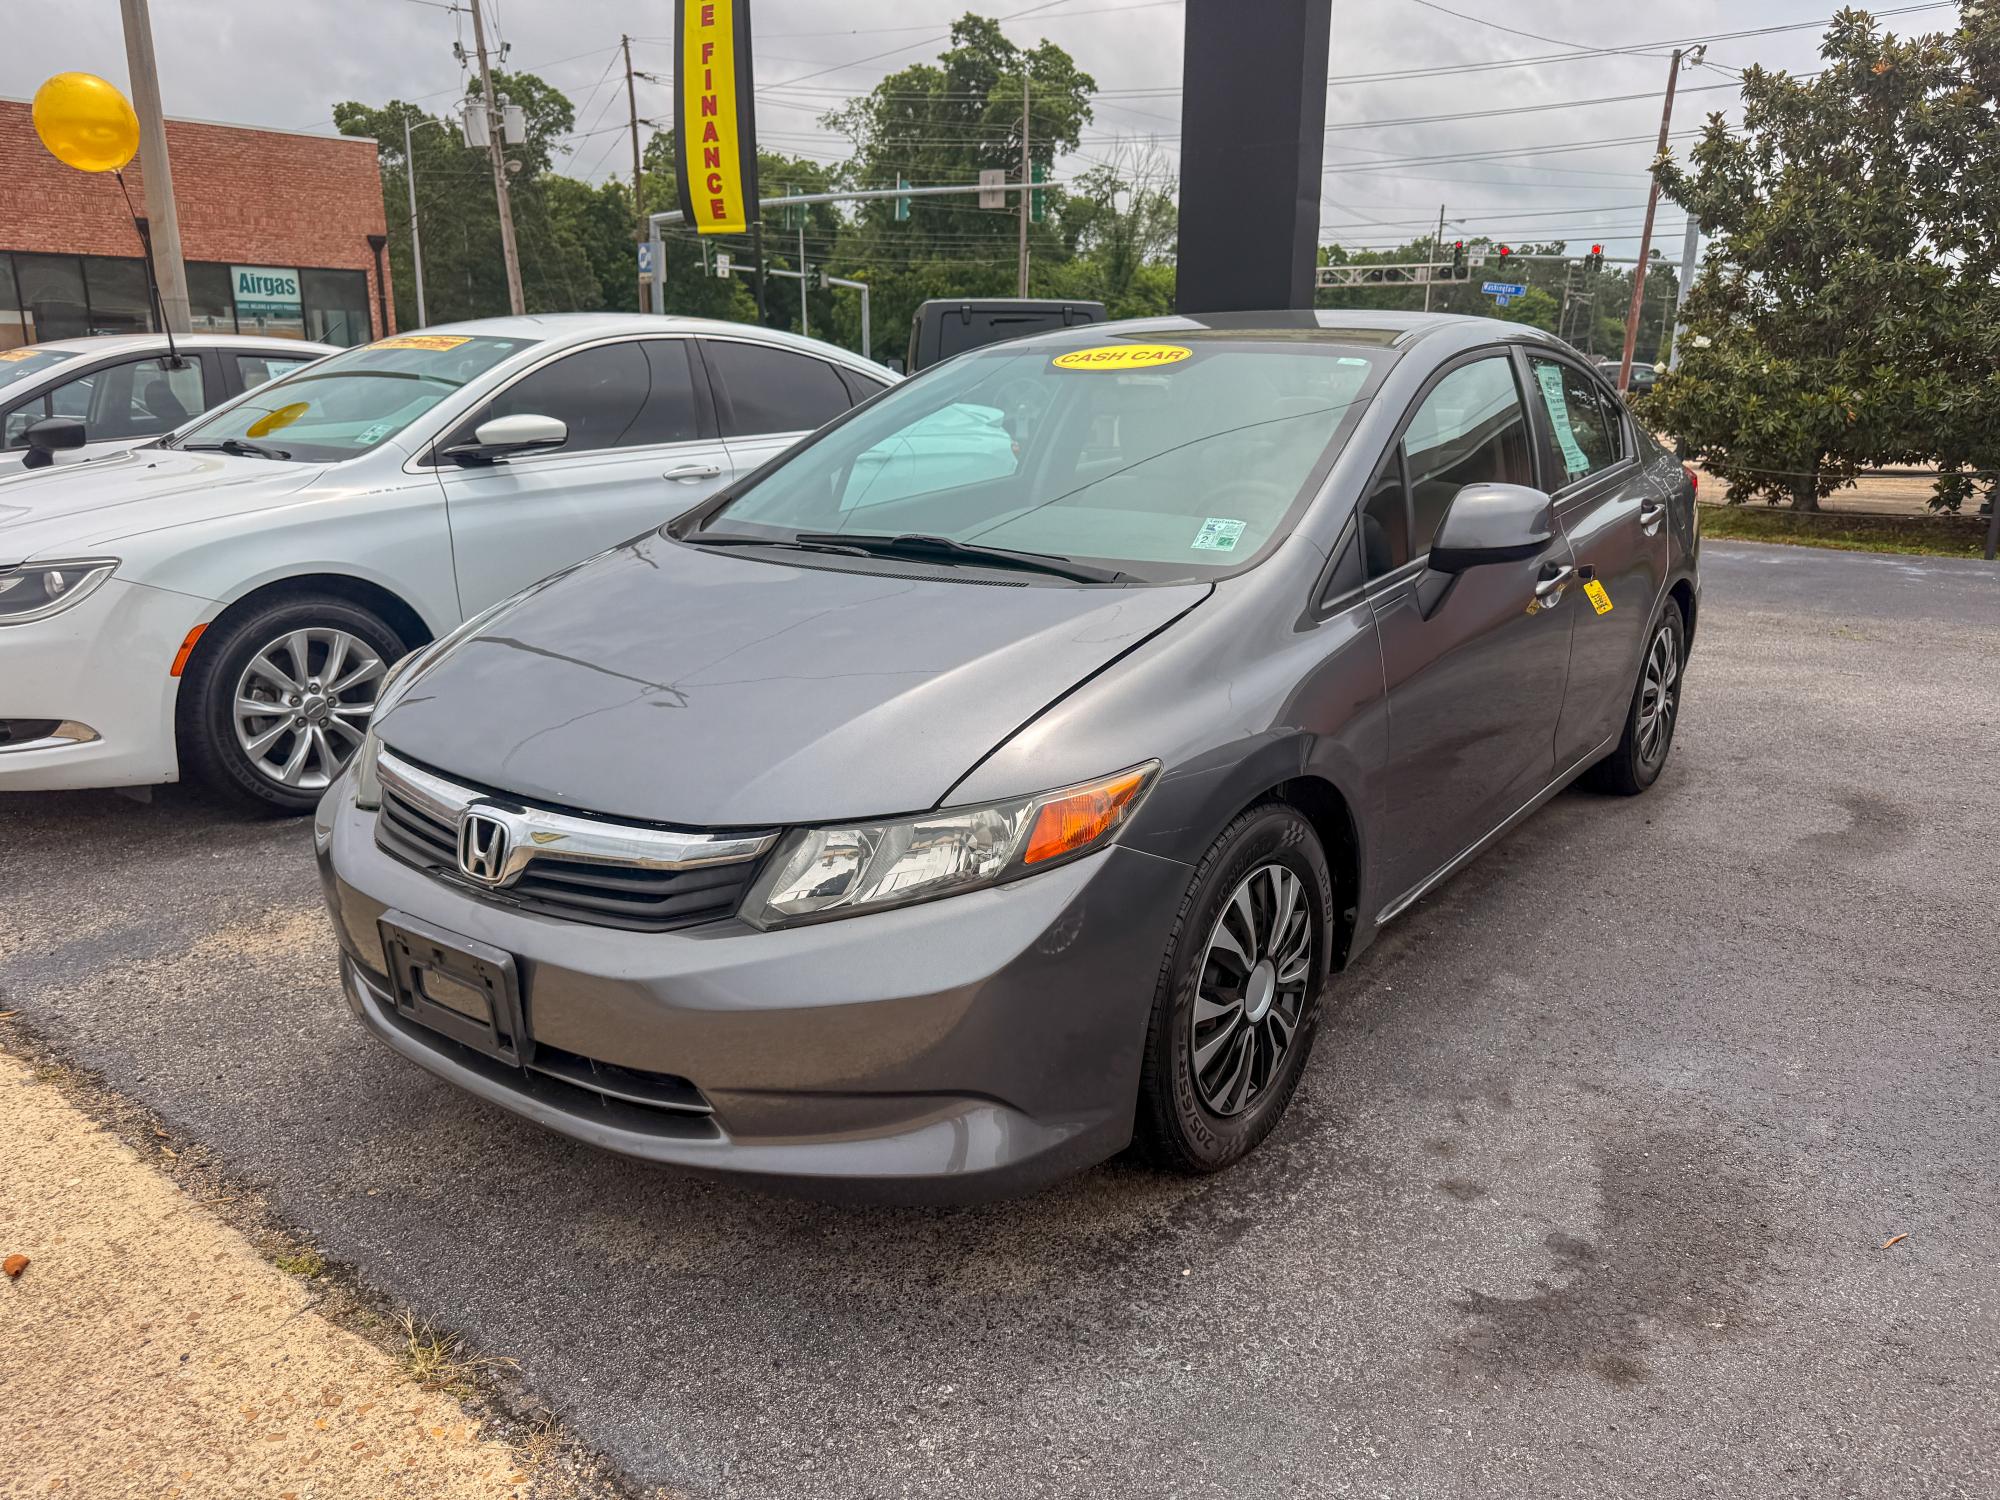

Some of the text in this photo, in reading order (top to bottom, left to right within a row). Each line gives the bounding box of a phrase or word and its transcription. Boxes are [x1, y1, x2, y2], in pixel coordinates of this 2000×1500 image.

[701, 42, 727, 220] FINANCE
[239, 272, 296, 297] Airgas
[1483, 282, 1515, 295] Washington
[1061, 351, 1184, 363] CASH CAR
[1317, 860, 1333, 925] LH-501
